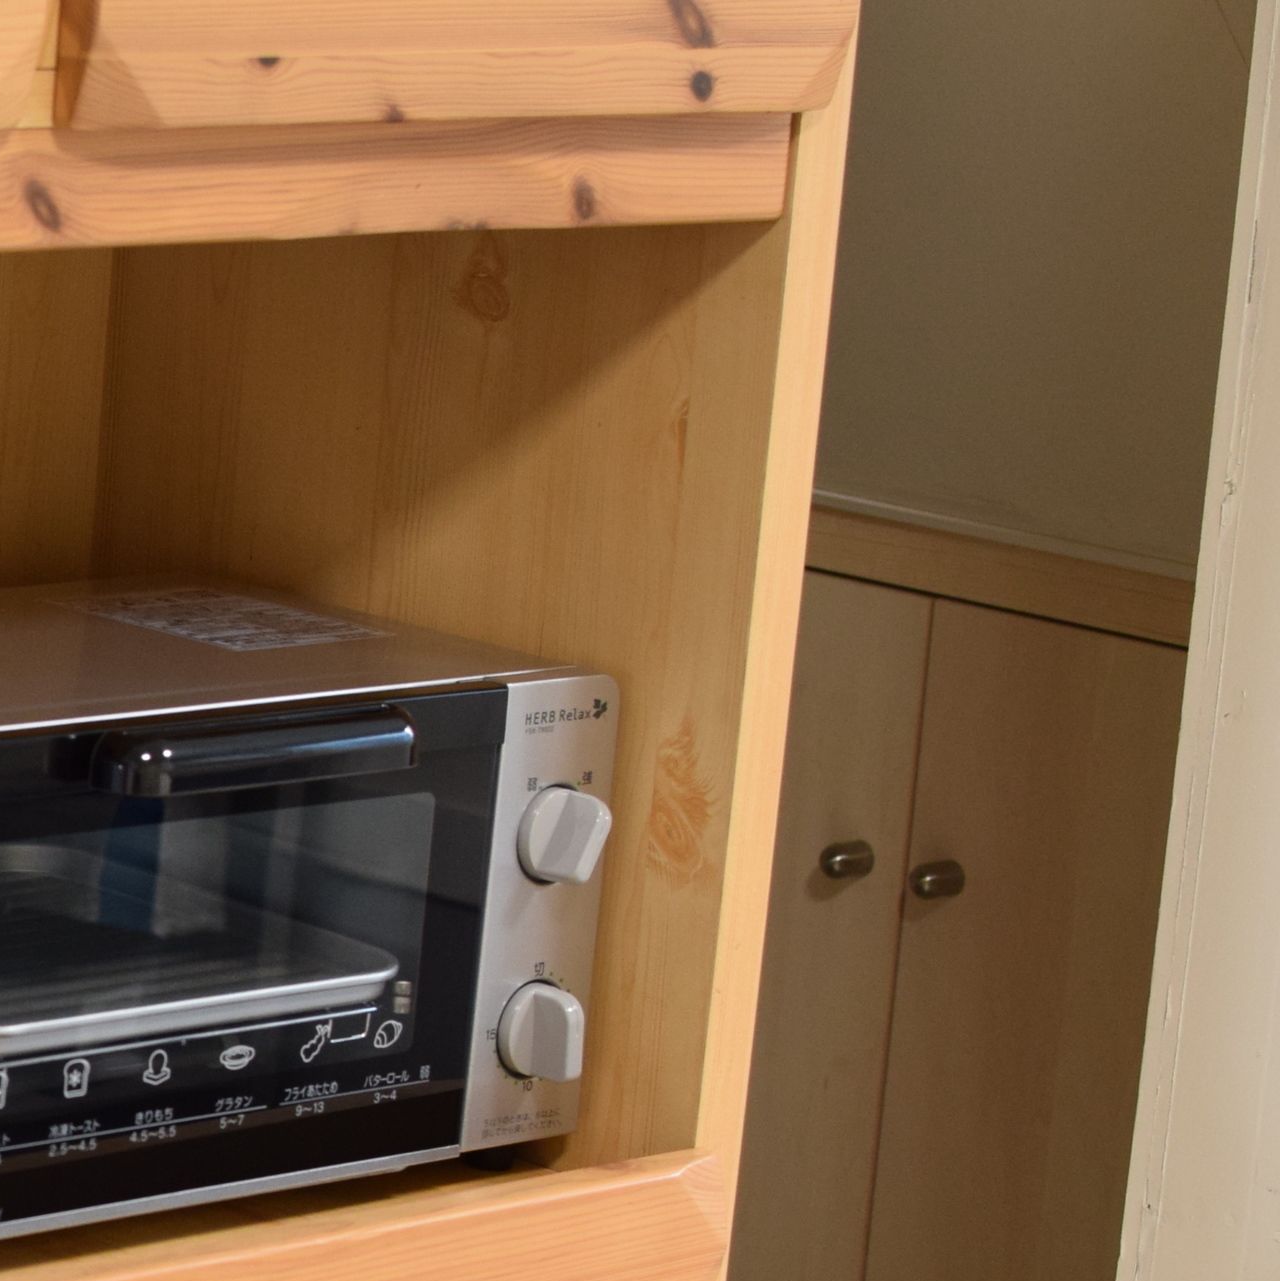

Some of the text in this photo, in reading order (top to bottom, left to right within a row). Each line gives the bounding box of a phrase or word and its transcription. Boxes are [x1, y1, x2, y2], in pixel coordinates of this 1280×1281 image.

[524, 707, 592, 726] HERB Relax
[283, 1081, 339, 1101] フライあたため
[522, 1081, 534, 1092] 10
[214, 1095, 253, 1112] グラタン
